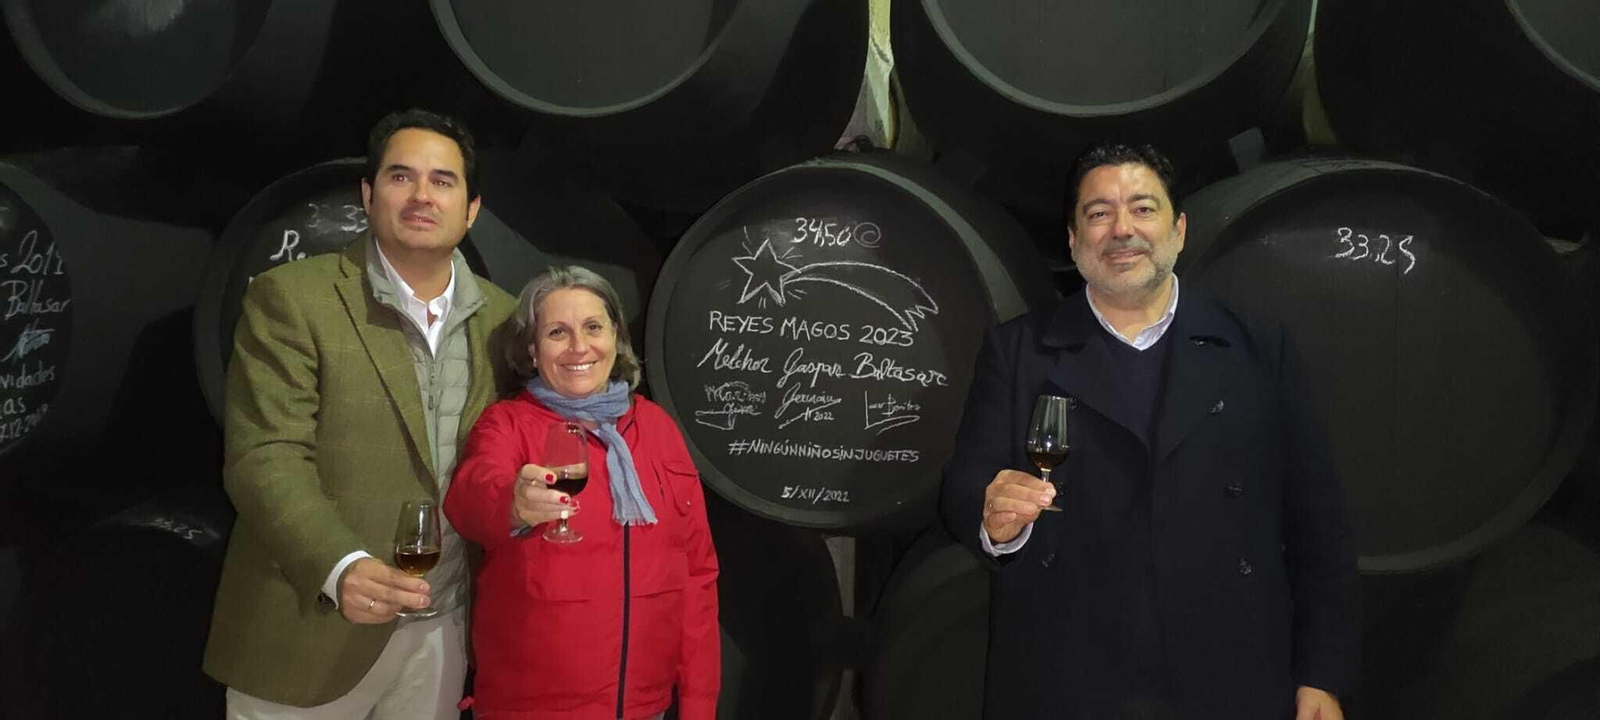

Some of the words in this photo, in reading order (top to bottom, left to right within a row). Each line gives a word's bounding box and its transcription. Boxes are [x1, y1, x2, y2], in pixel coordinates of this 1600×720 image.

[709, 310, 774, 334] REYES
[780, 316, 851, 341] MAGOS
[859, 324, 914, 347] 2023
[697, 338, 774, 374] Melchor
[776, 347, 846, 389] Gaspar
[781, 484, 851, 505] 5/XII/2022
